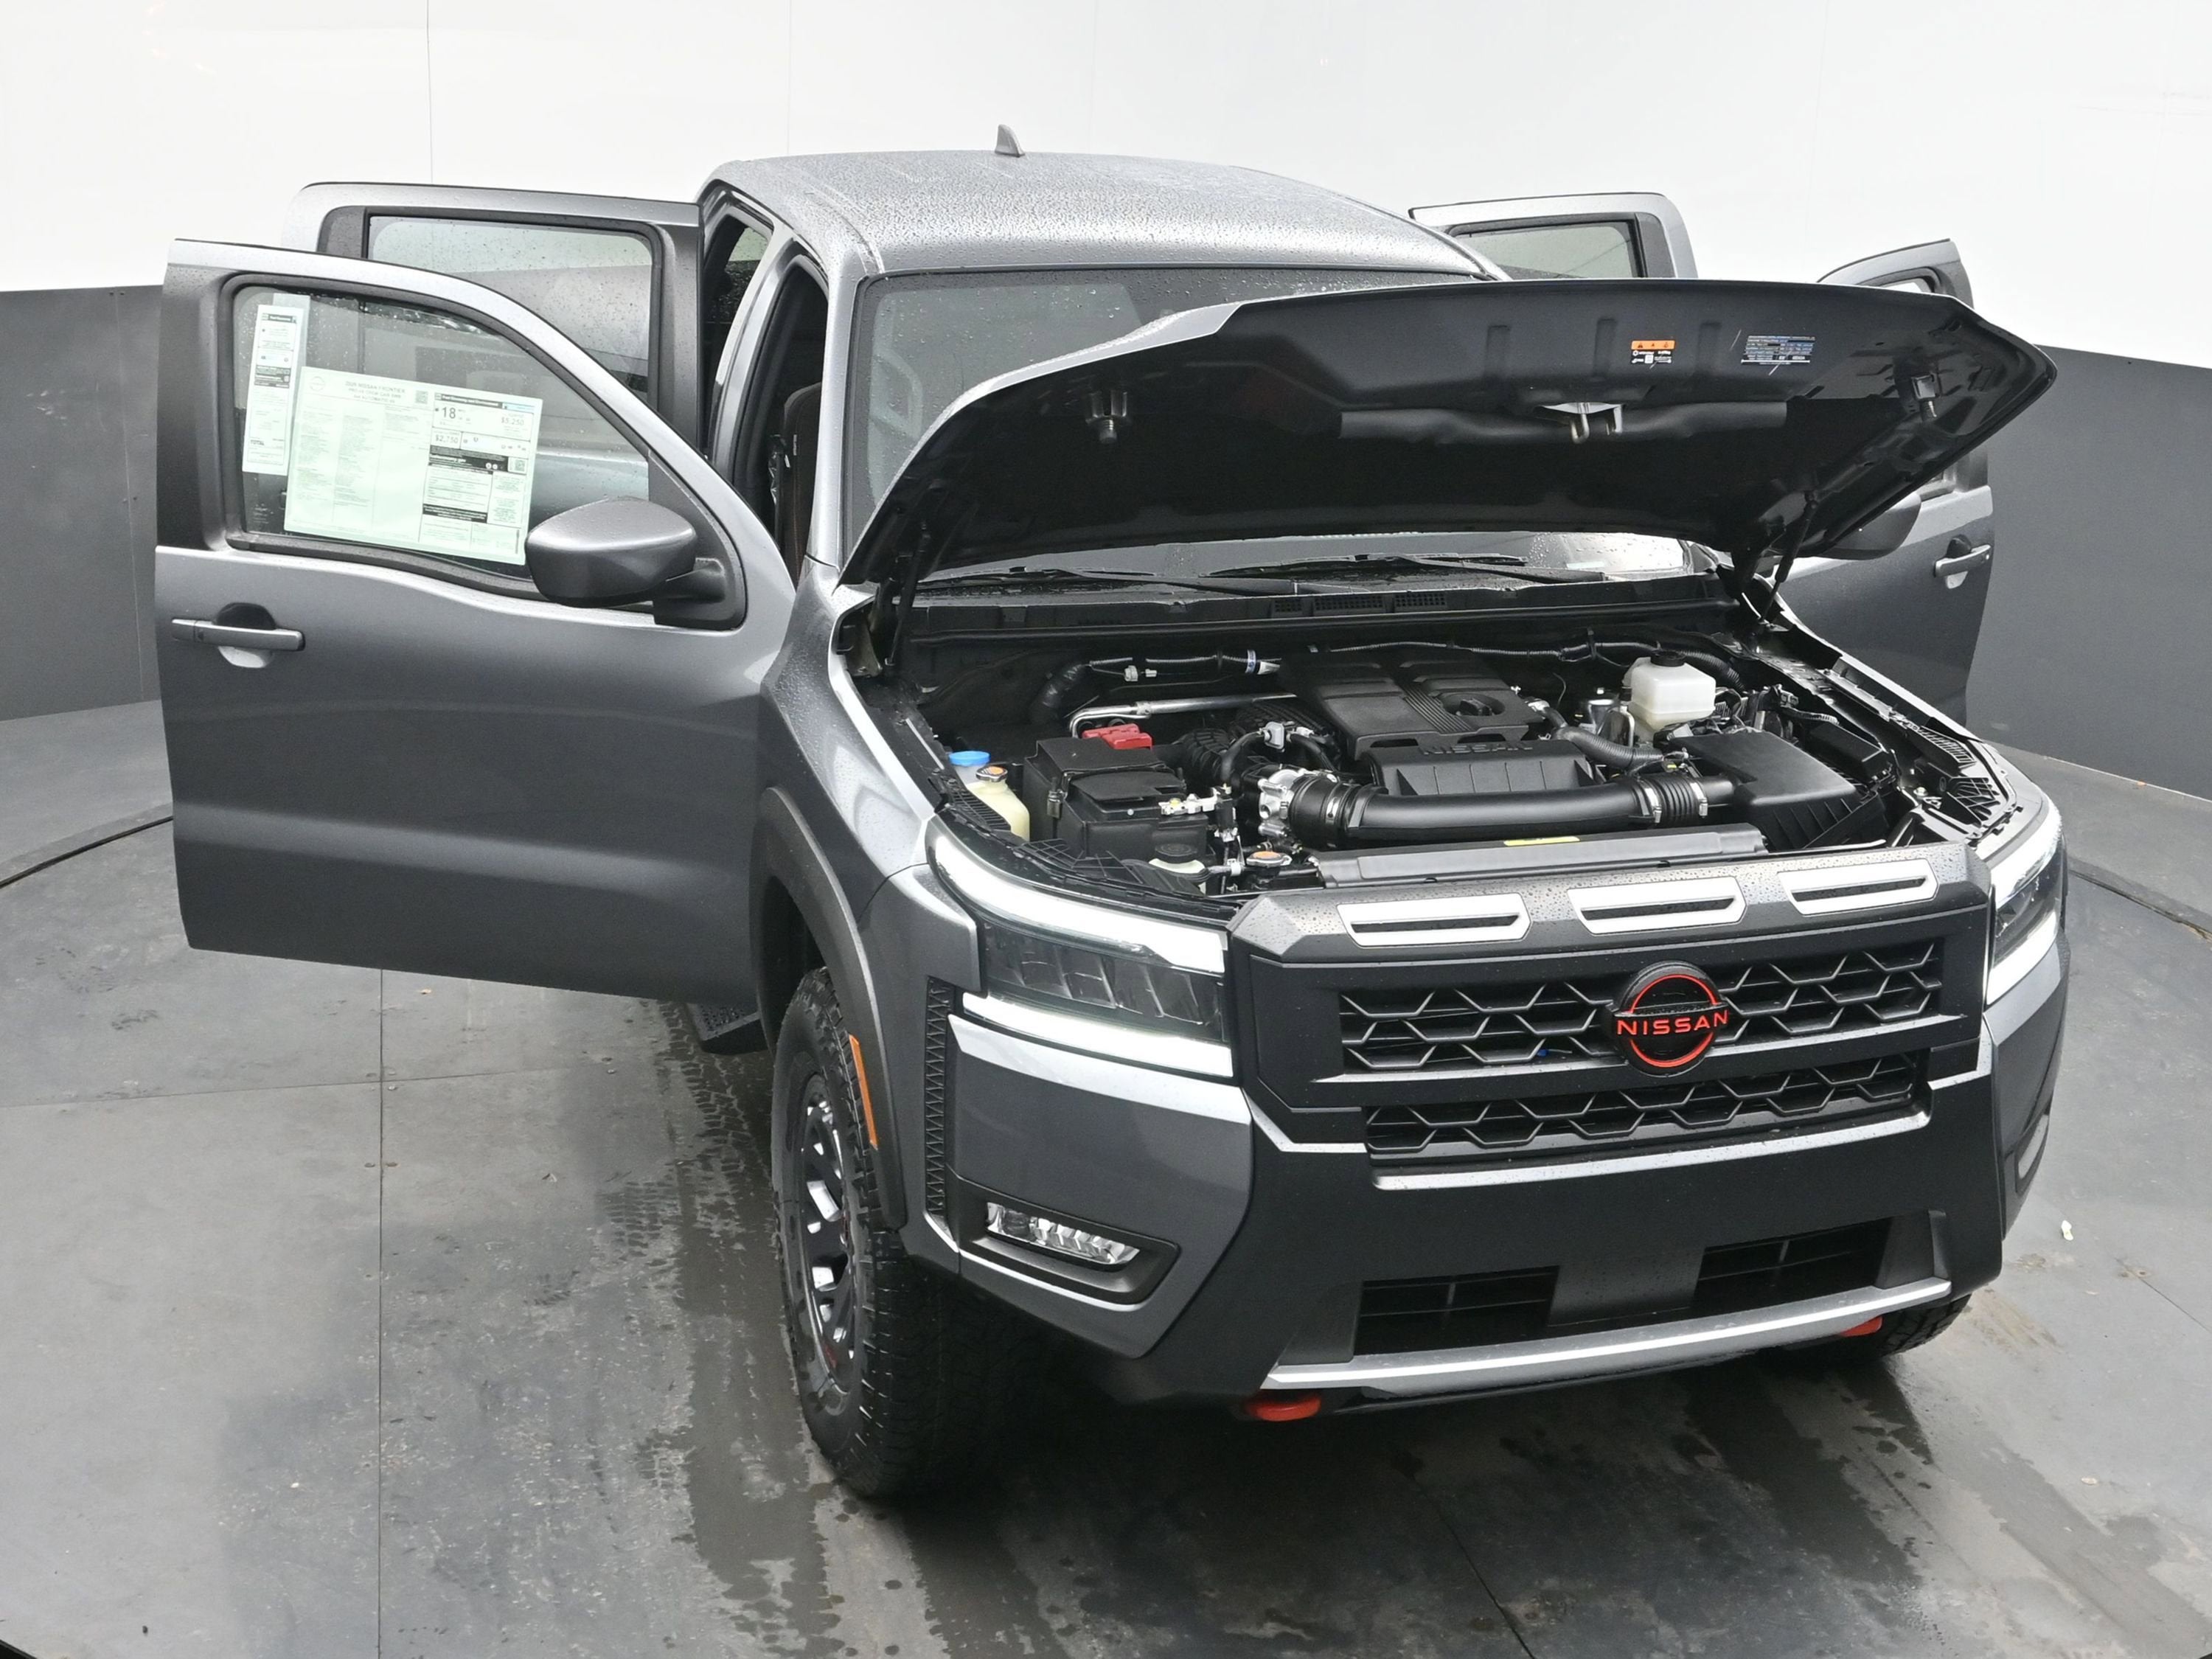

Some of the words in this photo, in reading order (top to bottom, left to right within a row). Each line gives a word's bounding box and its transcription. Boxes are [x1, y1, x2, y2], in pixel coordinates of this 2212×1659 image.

[442, 406, 456, 419] 18
[1419, 742, 1534, 756] NISSAN
[1617, 1009, 1728, 1036] NISSAN
